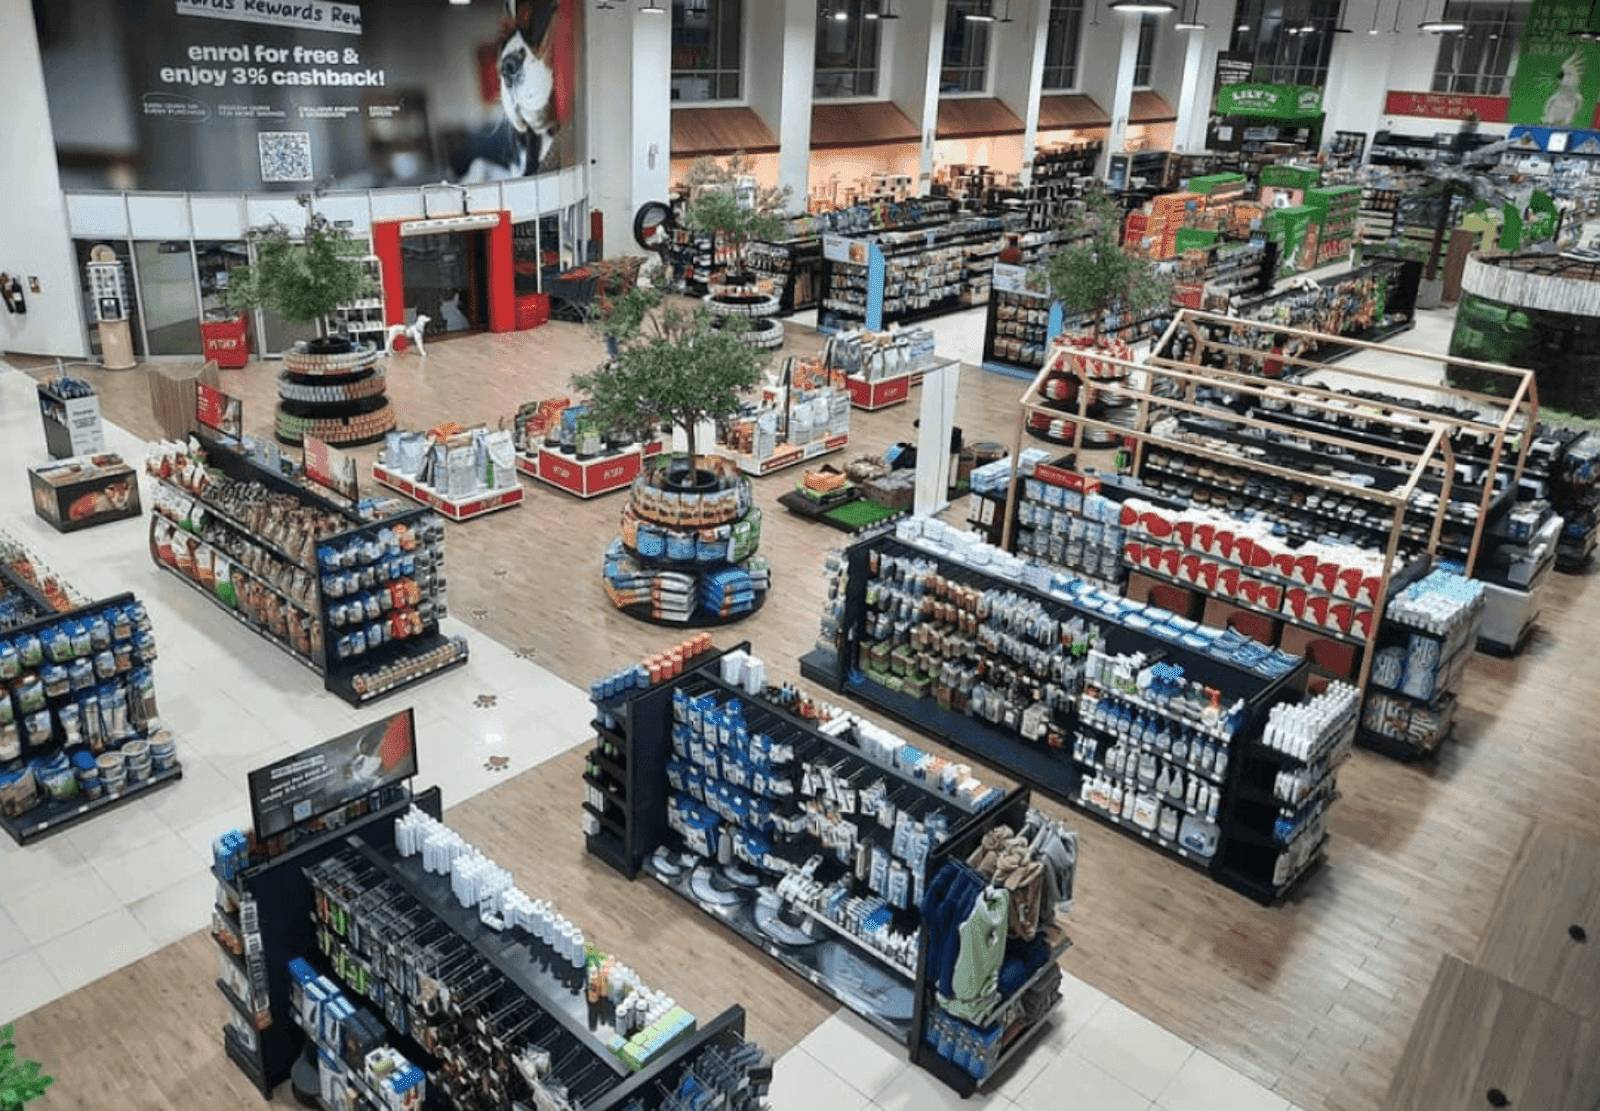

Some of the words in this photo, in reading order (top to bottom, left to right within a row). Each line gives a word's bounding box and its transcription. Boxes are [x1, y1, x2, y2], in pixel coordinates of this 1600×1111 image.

[188, 44, 249, 62] enrol
[254, 45, 289, 63] for
[293, 46, 339, 64] free
[343, 47, 360, 65] &
[160, 65, 227, 86] enjoy
[232, 67, 268, 85] 3%
[271, 69, 385, 87] cashback!
